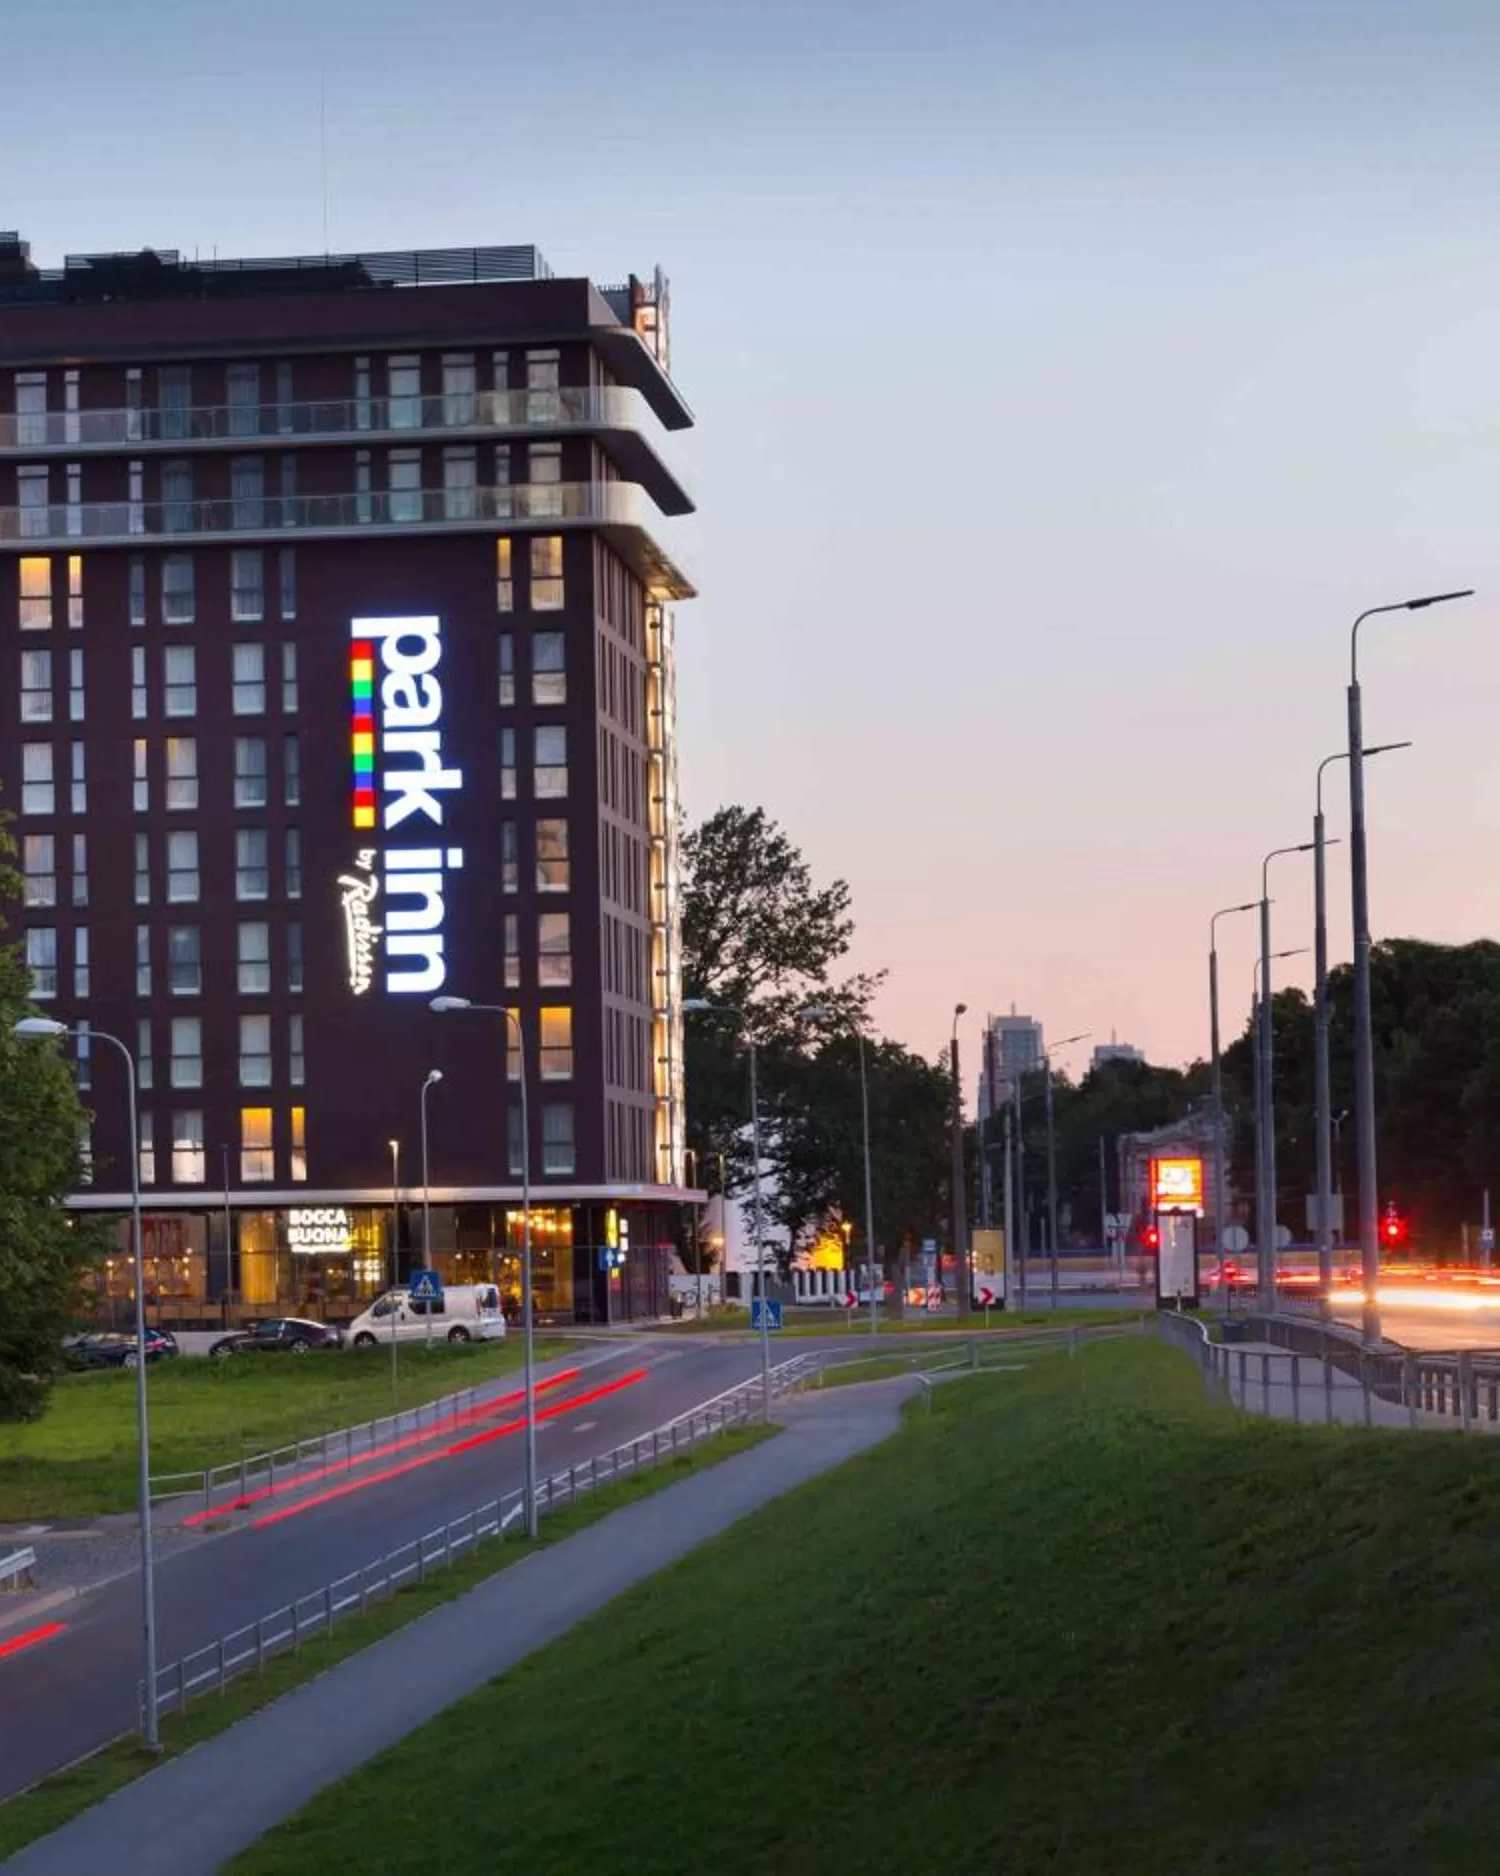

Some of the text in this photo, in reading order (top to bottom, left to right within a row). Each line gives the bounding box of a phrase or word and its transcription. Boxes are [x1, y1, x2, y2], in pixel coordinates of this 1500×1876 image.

[337, 848, 384, 995] by Radisson
[351, 615, 464, 994] park inn
